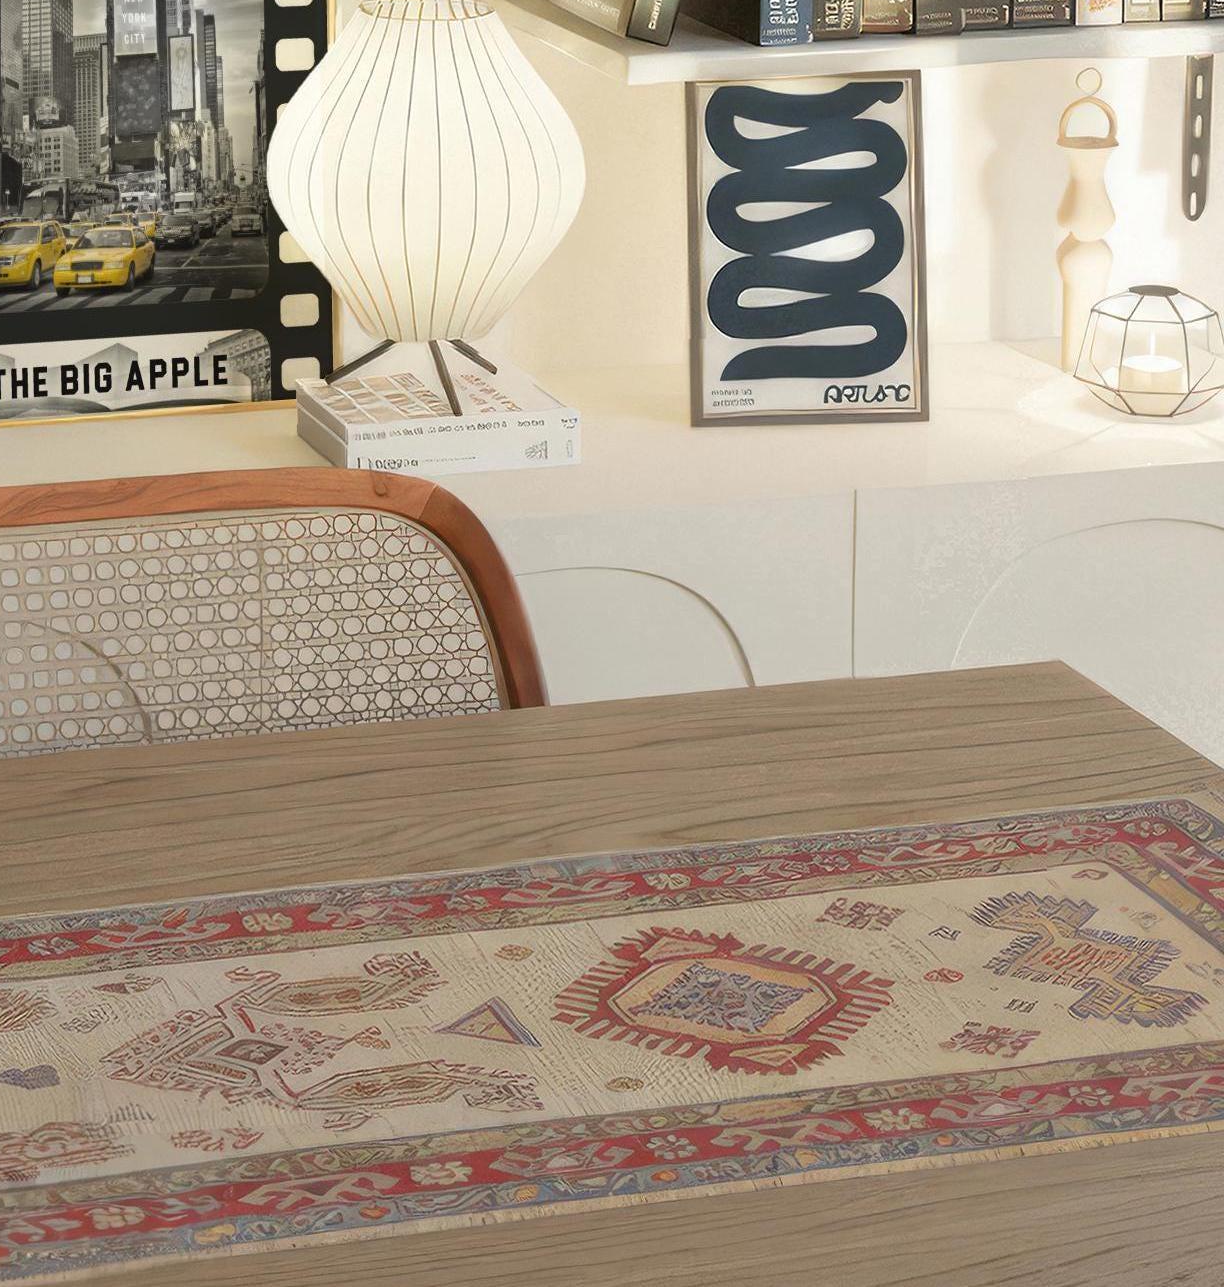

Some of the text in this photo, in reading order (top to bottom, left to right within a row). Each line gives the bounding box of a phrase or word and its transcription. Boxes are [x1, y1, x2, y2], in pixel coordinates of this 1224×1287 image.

[121, 12, 147, 23] YORK
[124, 33, 146, 45] CITY
[60, 361, 112, 396] BIG
[125, 354, 228, 391] APPLE
